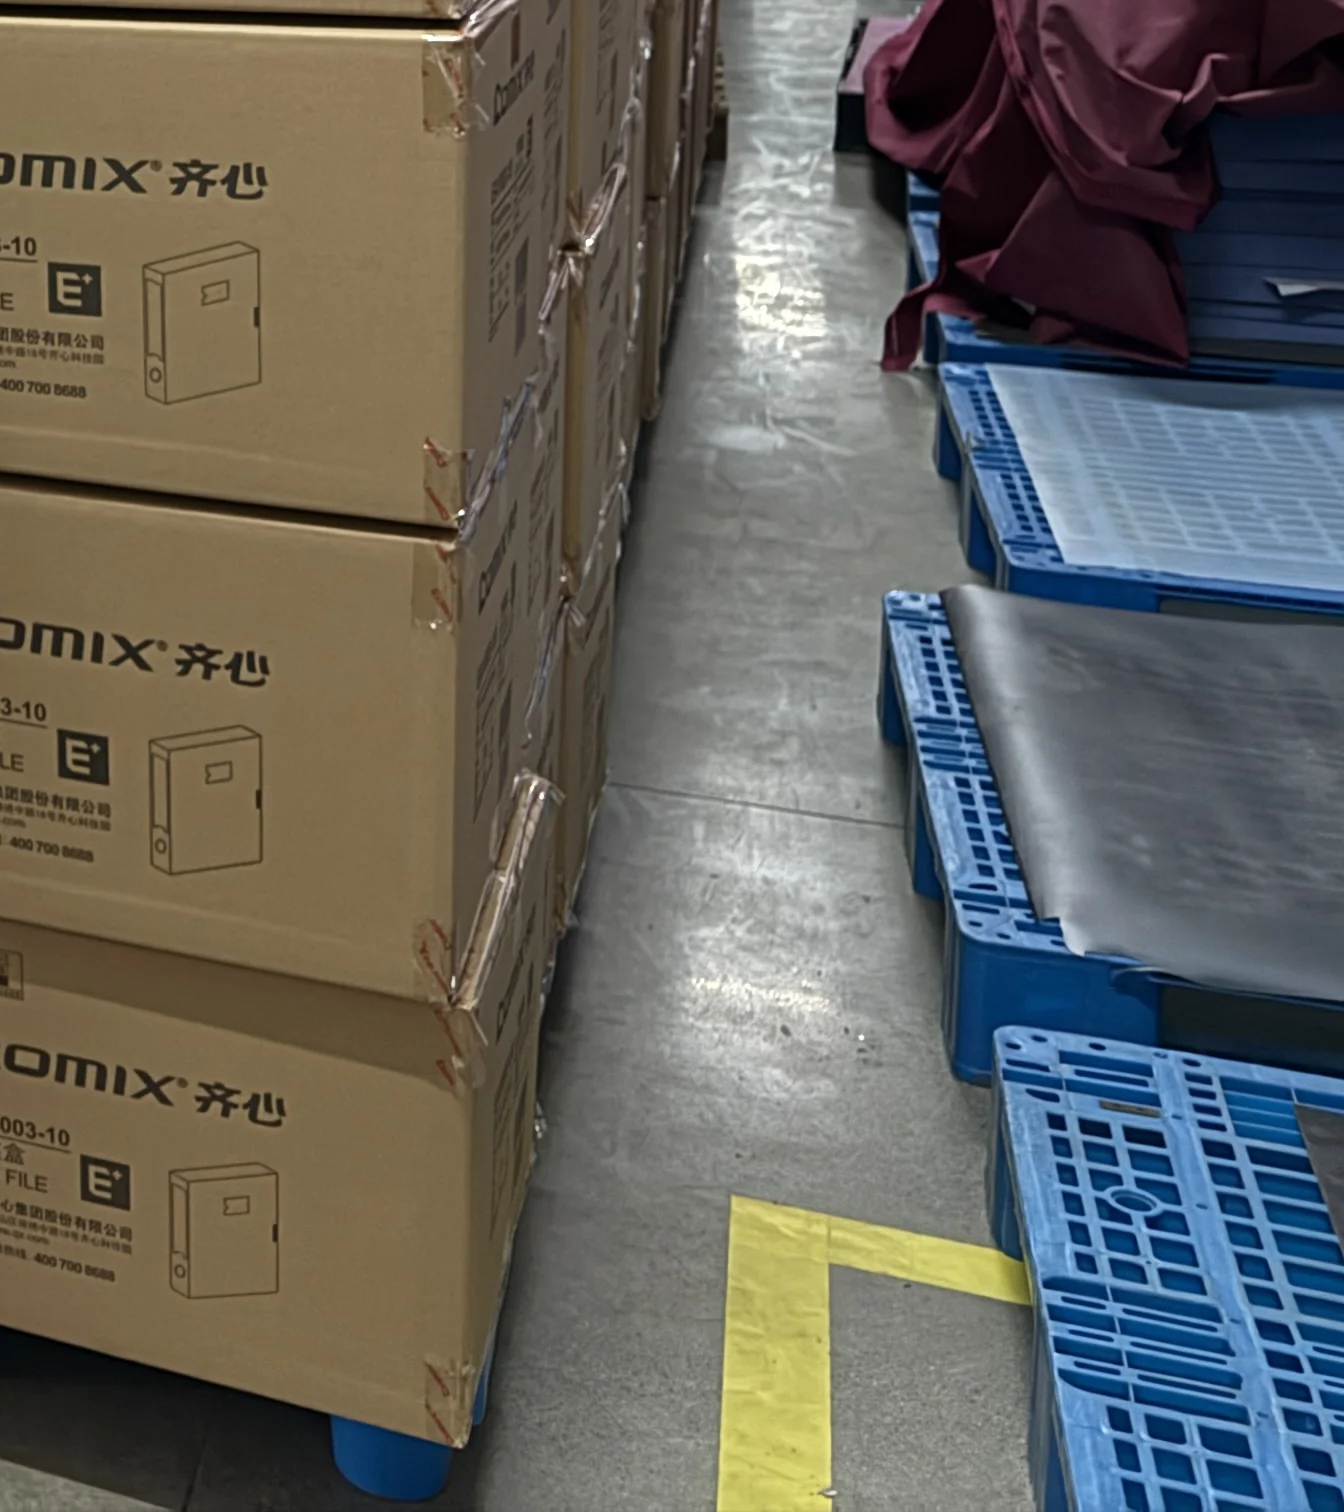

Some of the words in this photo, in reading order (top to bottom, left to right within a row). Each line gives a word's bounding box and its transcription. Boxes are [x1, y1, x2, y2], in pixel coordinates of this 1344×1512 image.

[169, 159, 269, 201] 齐心
[0, 378, 25, 393] 400
[27, 381, 52, 396] 700
[175, 642, 271, 688] 齐心
[194, 1080, 289, 1129] 齐心
[5, 1168, 49, 1194] FILE
